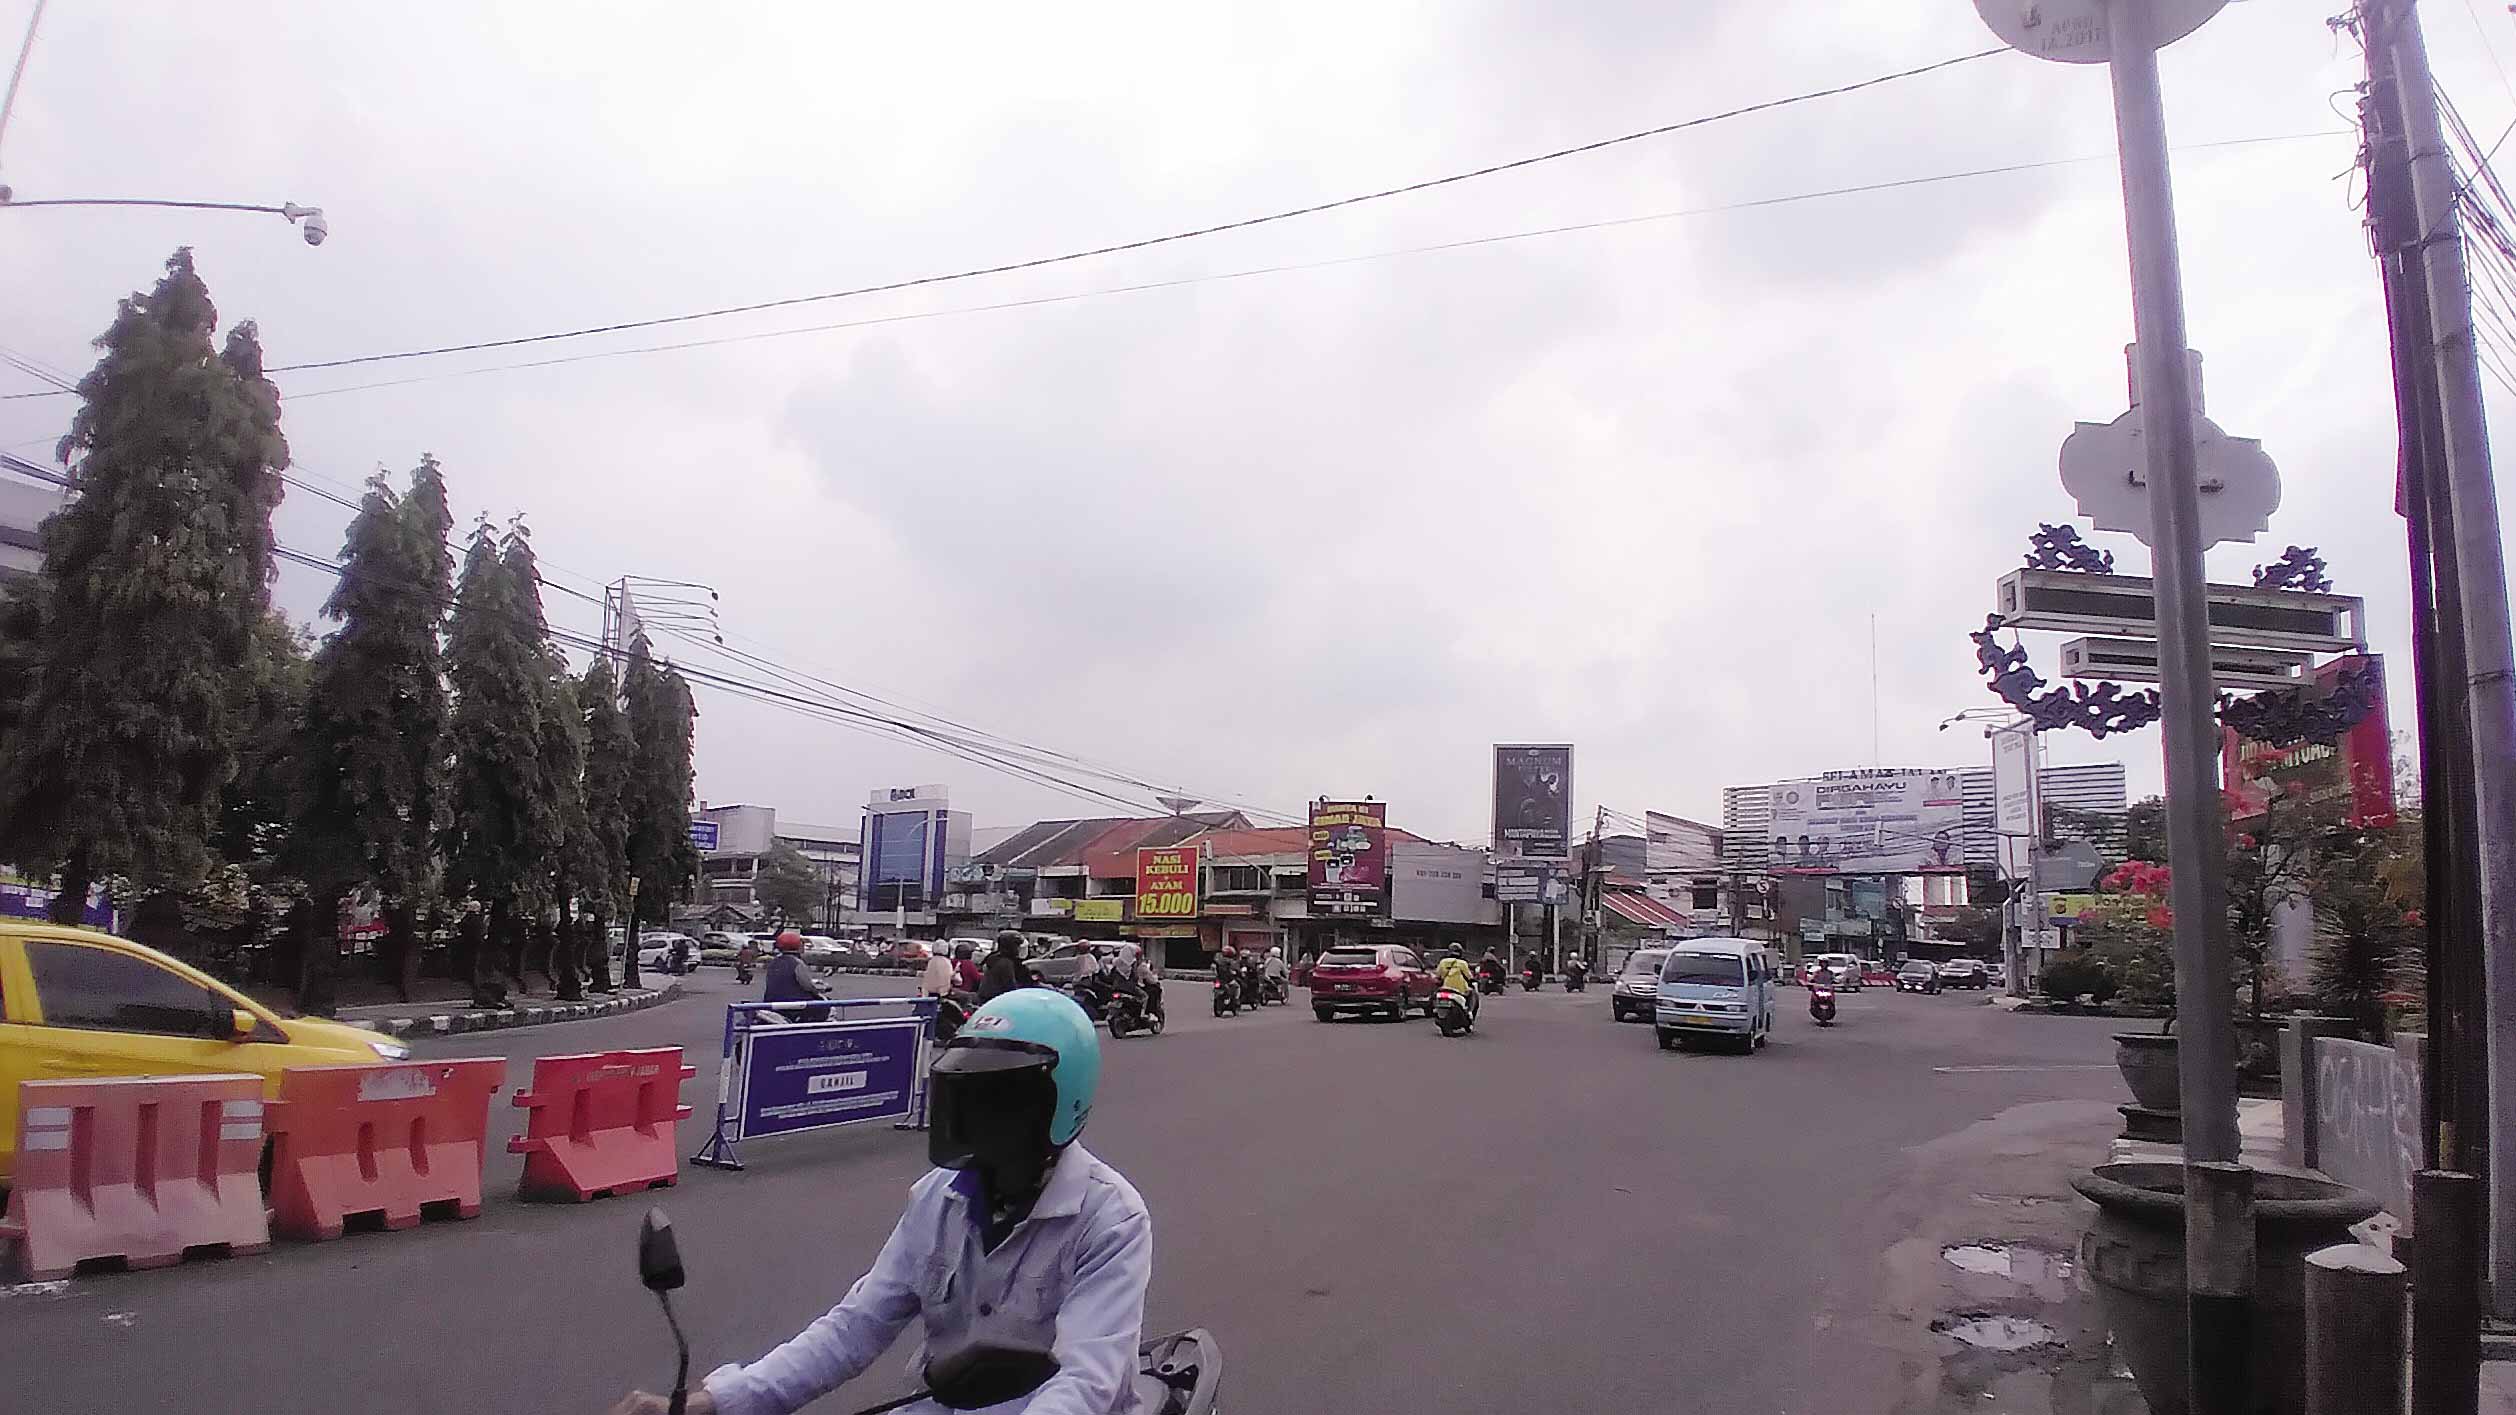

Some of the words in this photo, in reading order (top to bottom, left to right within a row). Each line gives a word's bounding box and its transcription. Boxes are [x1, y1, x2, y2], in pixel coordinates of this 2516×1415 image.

[1506, 756, 1562, 767] MAGNUM
[1816, 782, 1907, 794] DIRGAHAYU
[1153, 855, 1182, 865] NASI
[1145, 864, 1189, 875] KEBULI
[1150, 881, 1183, 891] AYAM
[1139, 893, 1194, 914] 15.000
